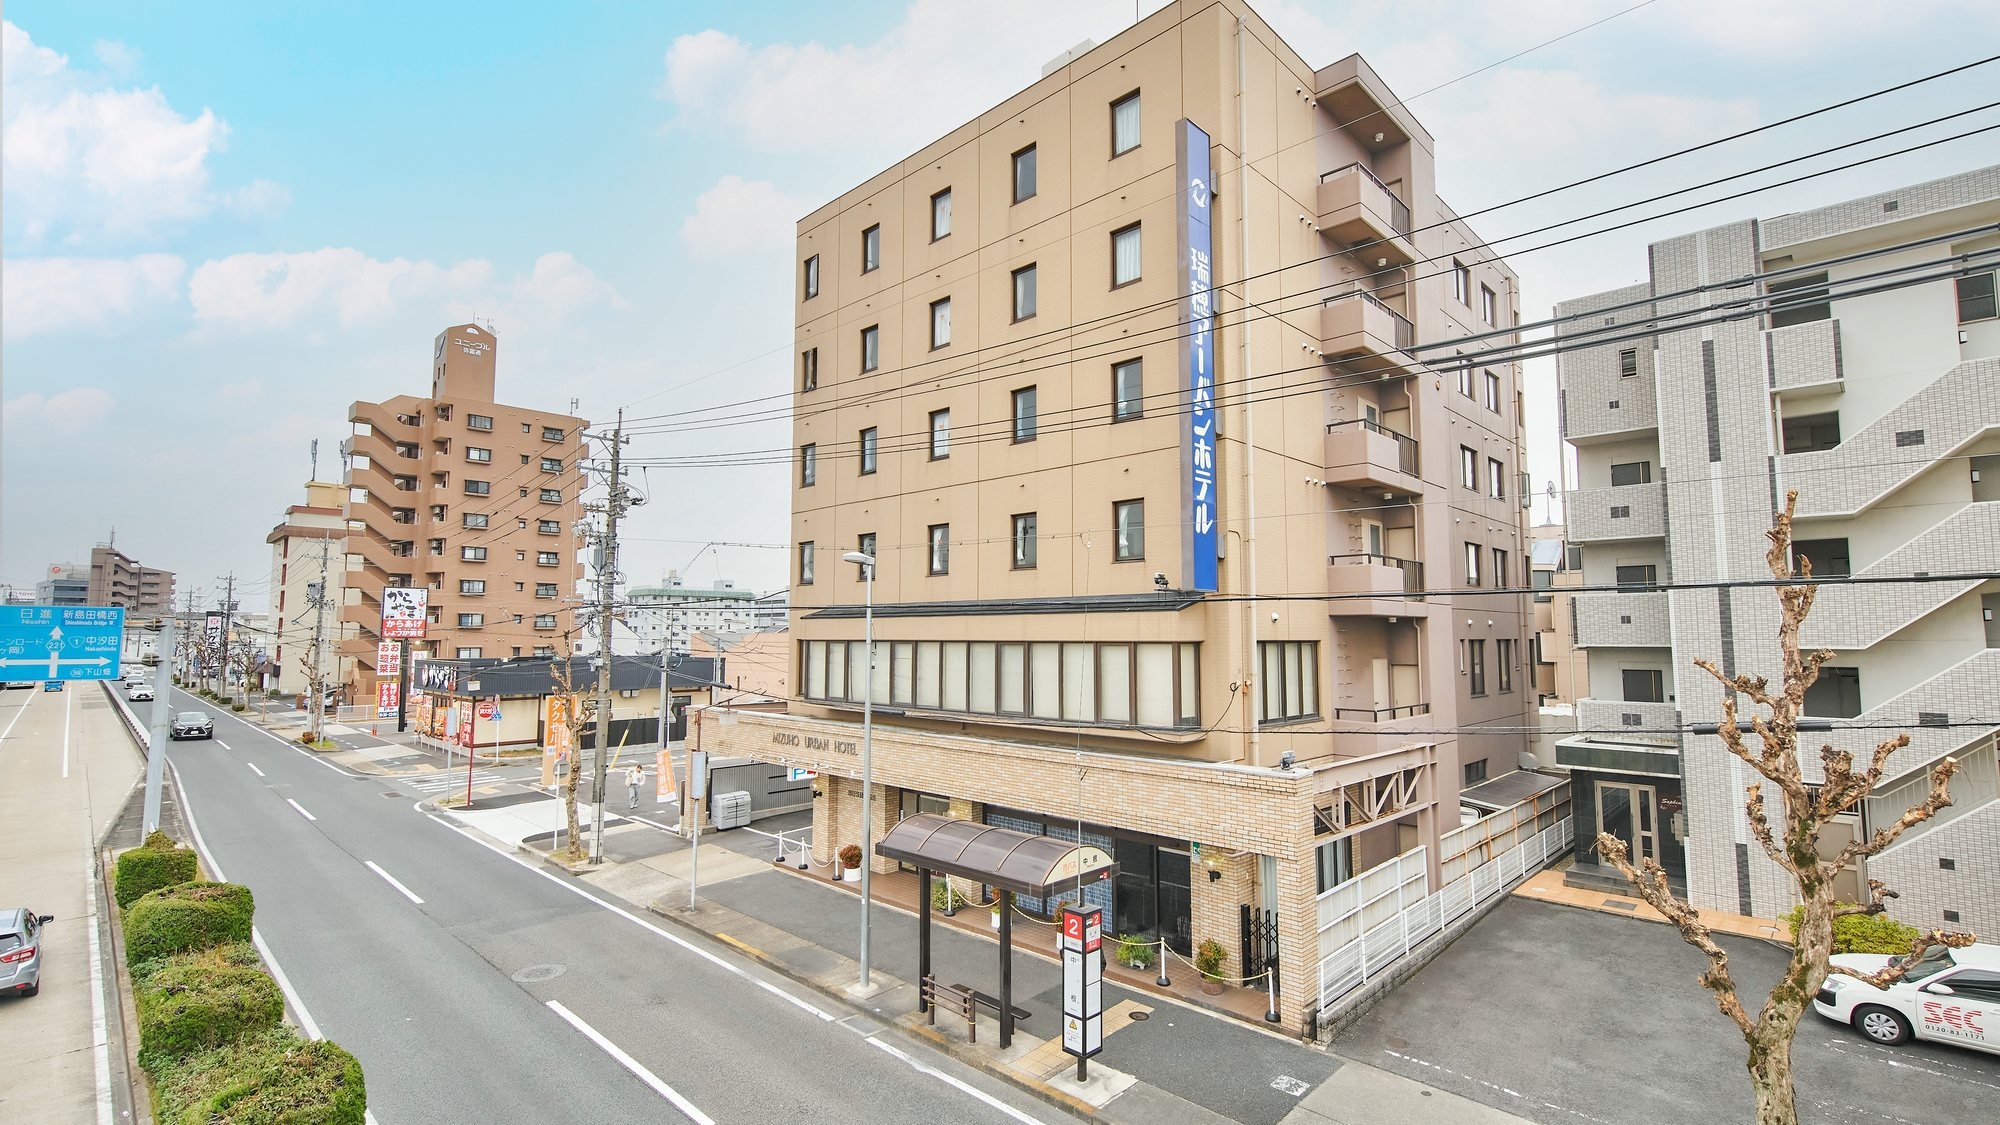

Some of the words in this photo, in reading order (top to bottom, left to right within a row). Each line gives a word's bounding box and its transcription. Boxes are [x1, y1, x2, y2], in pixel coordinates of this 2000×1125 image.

[21, 608, 52, 619] 日進
[63, 610, 118, 620] 新島田橋西
[386, 620, 423, 628] からあげ
[48, 641, 63, 650] 221
[86, 636, 118, 646] 中汐田
[389, 644, 400, 673] お弁当
[772, 732, 800, 747] MIZUHO
[804, 736, 829, 751] URBAN
[834, 740, 859, 756] HOTEL
[794, 768, 806, 780] P
[1094, 915, 1099, 925] 2
[1069, 918, 1079, 936] 2
[1924, 1001, 1983, 1033] SEC
[1925, 1025, 1985, 1040] 0120-83-1171
